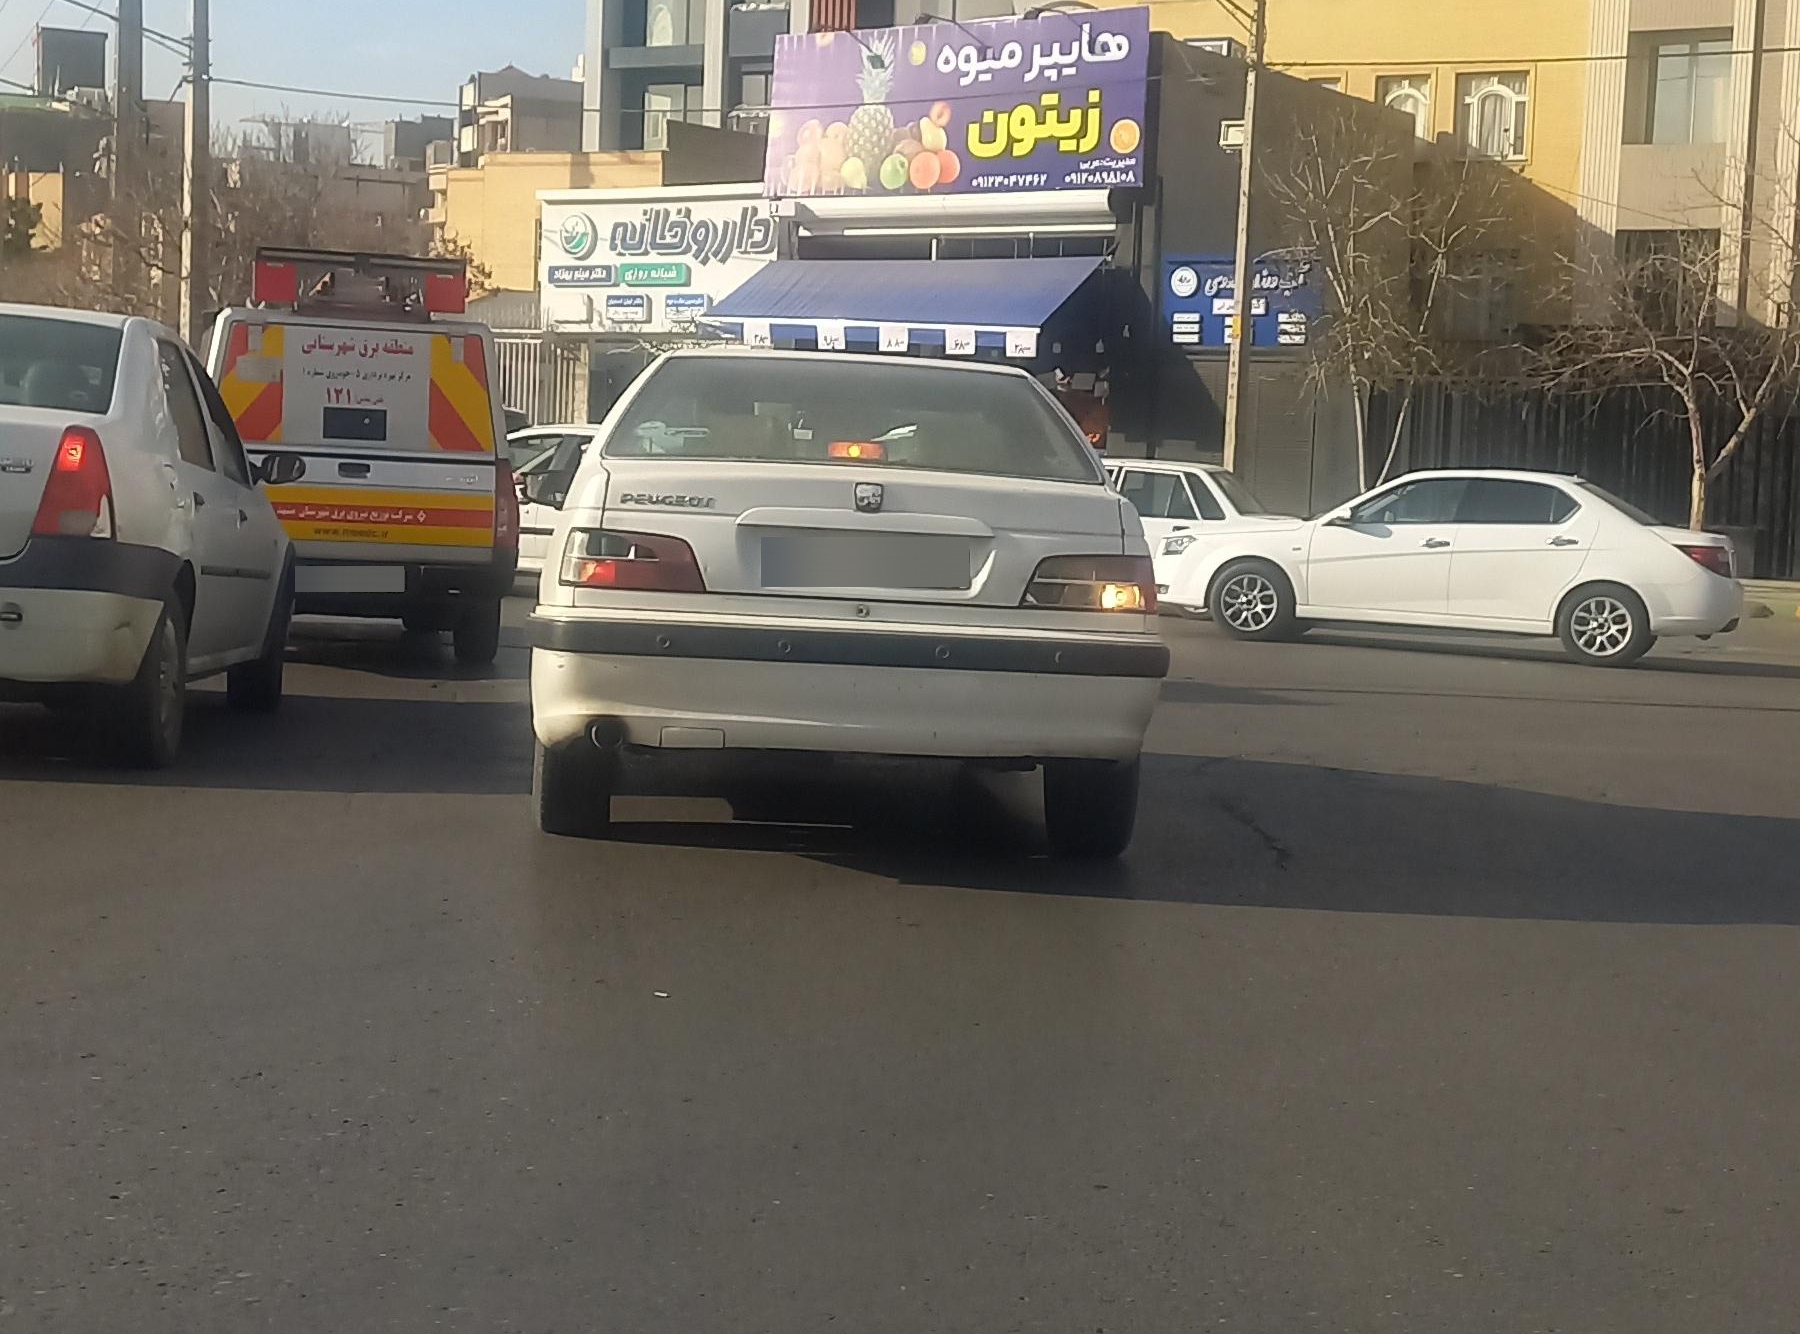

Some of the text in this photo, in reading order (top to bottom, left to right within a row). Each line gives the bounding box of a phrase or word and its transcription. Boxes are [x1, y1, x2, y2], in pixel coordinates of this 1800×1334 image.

[936, 22, 1130, 87] هایپر میوه
[966, 88, 1103, 158] زیتون
[609, 207, 778, 264] داروخانه
[624, 266, 677, 281] شبانه روزی
[359, 339, 379, 358] برق
[620, 492, 717, 508] PEUGEOT
